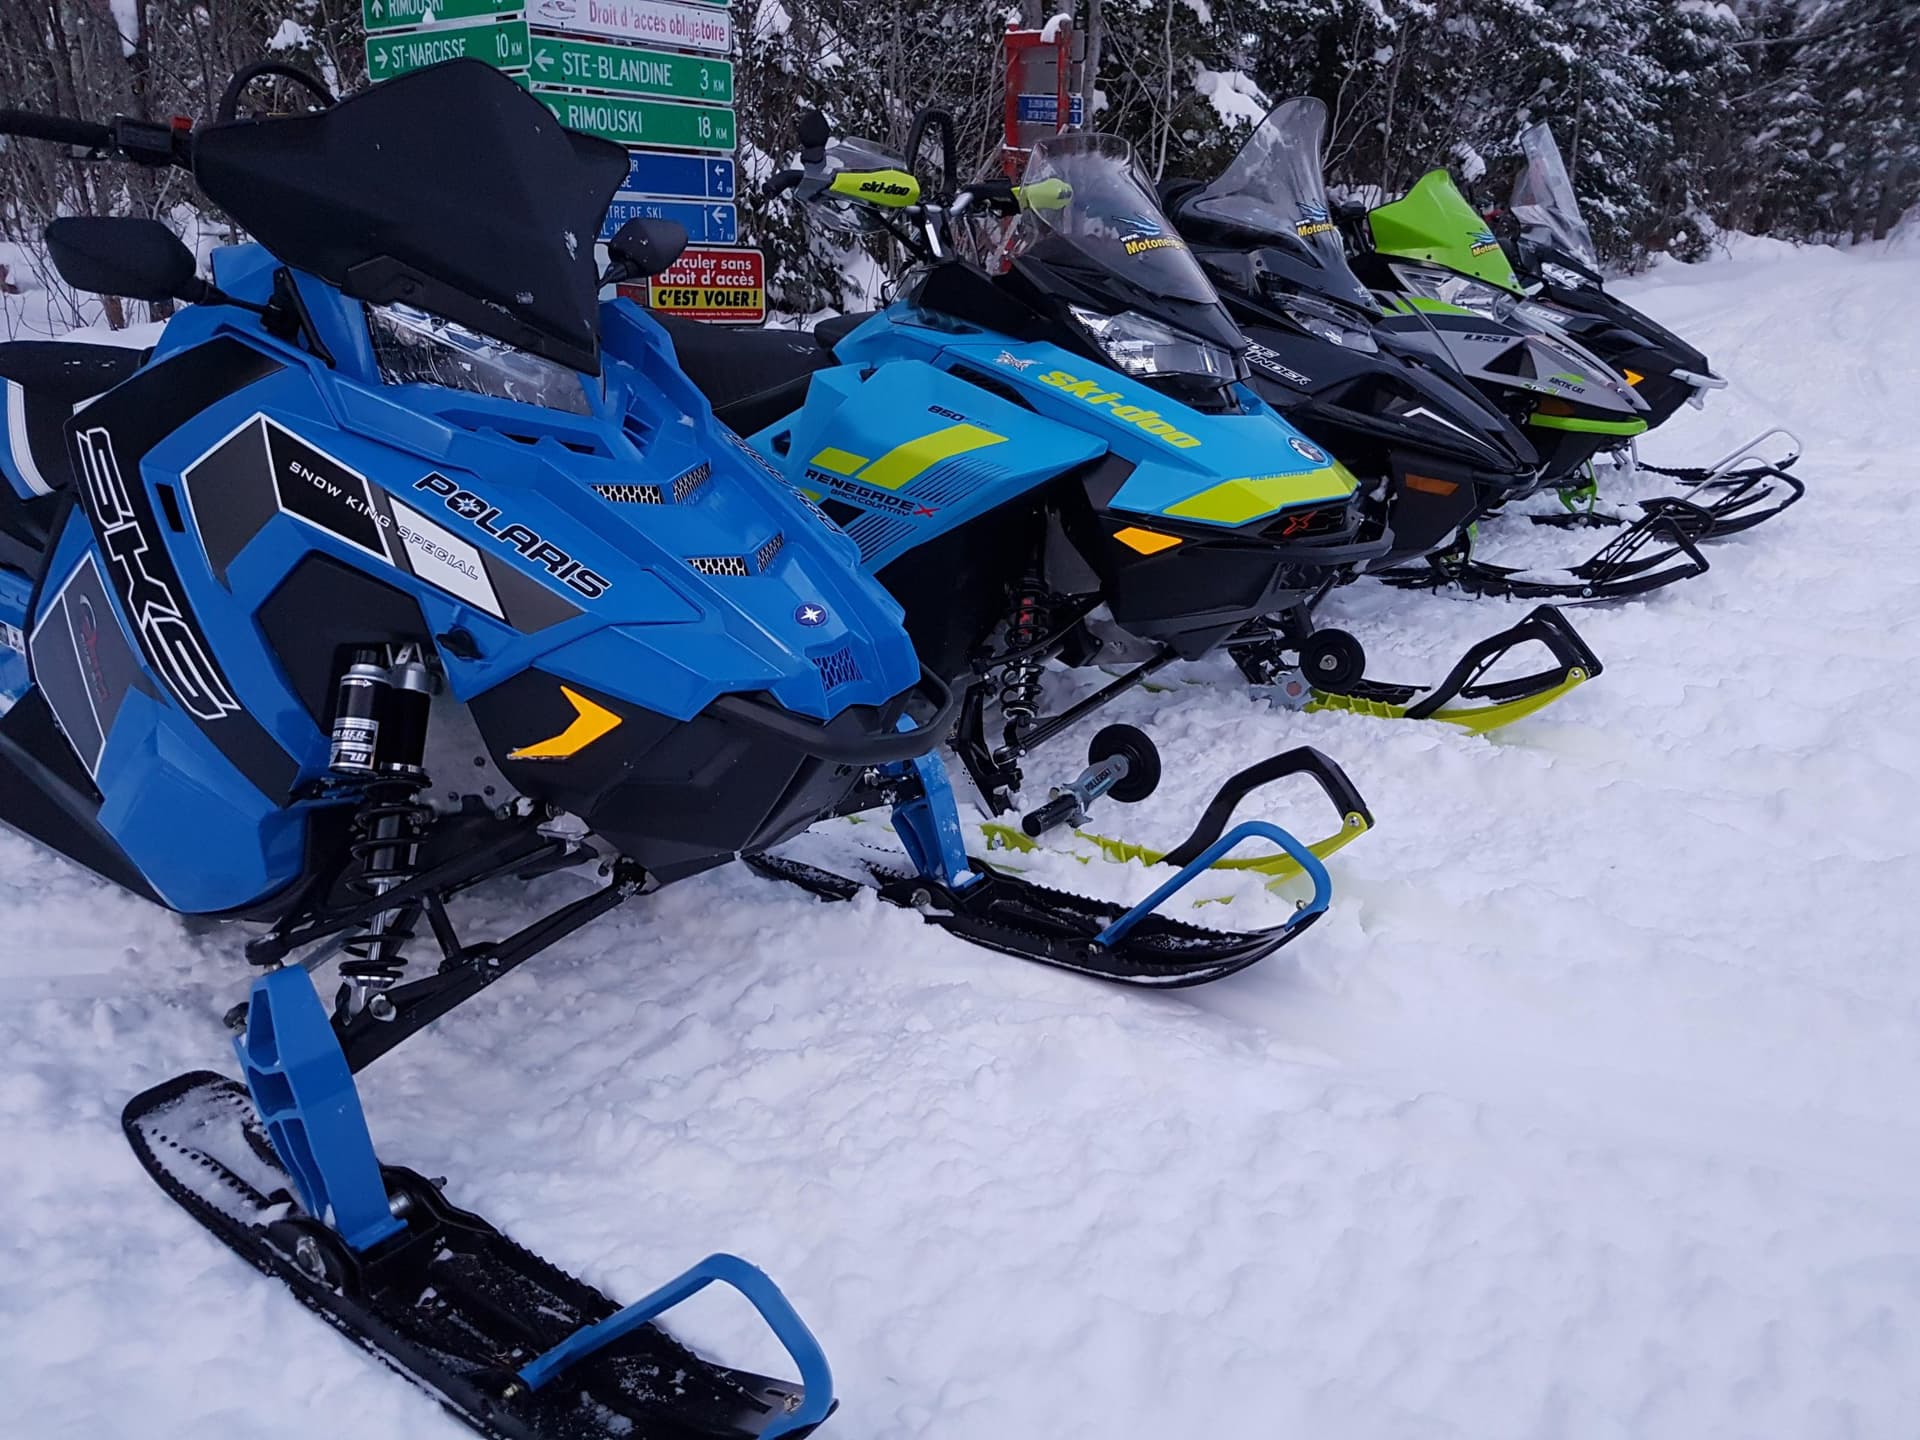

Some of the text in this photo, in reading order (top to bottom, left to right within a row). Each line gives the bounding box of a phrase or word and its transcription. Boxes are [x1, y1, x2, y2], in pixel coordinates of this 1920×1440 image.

[589, 0, 617, 26] Droit
[670, 14, 725, 42] obligatoire
[391, 33, 522, 68] ST-NARCISSE 10 KM
[562, 52, 725, 92] STE-BLANDINE 3 KM
[568, 105, 727, 140] RIMOUSKI 18 KM
[717, 181, 723, 193] 4
[647, 206, 662, 219] SKI
[660, 269, 755, 286] droit d'accès
[672, 254, 751, 270] rculer sans
[658, 290, 698, 306] C'EST
[928, 405, 966, 421] 850
[1038, 371, 1202, 449] ski-doo
[804, 468, 916, 511] RENEGADE
[289, 461, 480, 581] SNOW KING SPECIAL
[412, 470, 613, 600] POLARIS
[76, 426, 241, 720] SKS
